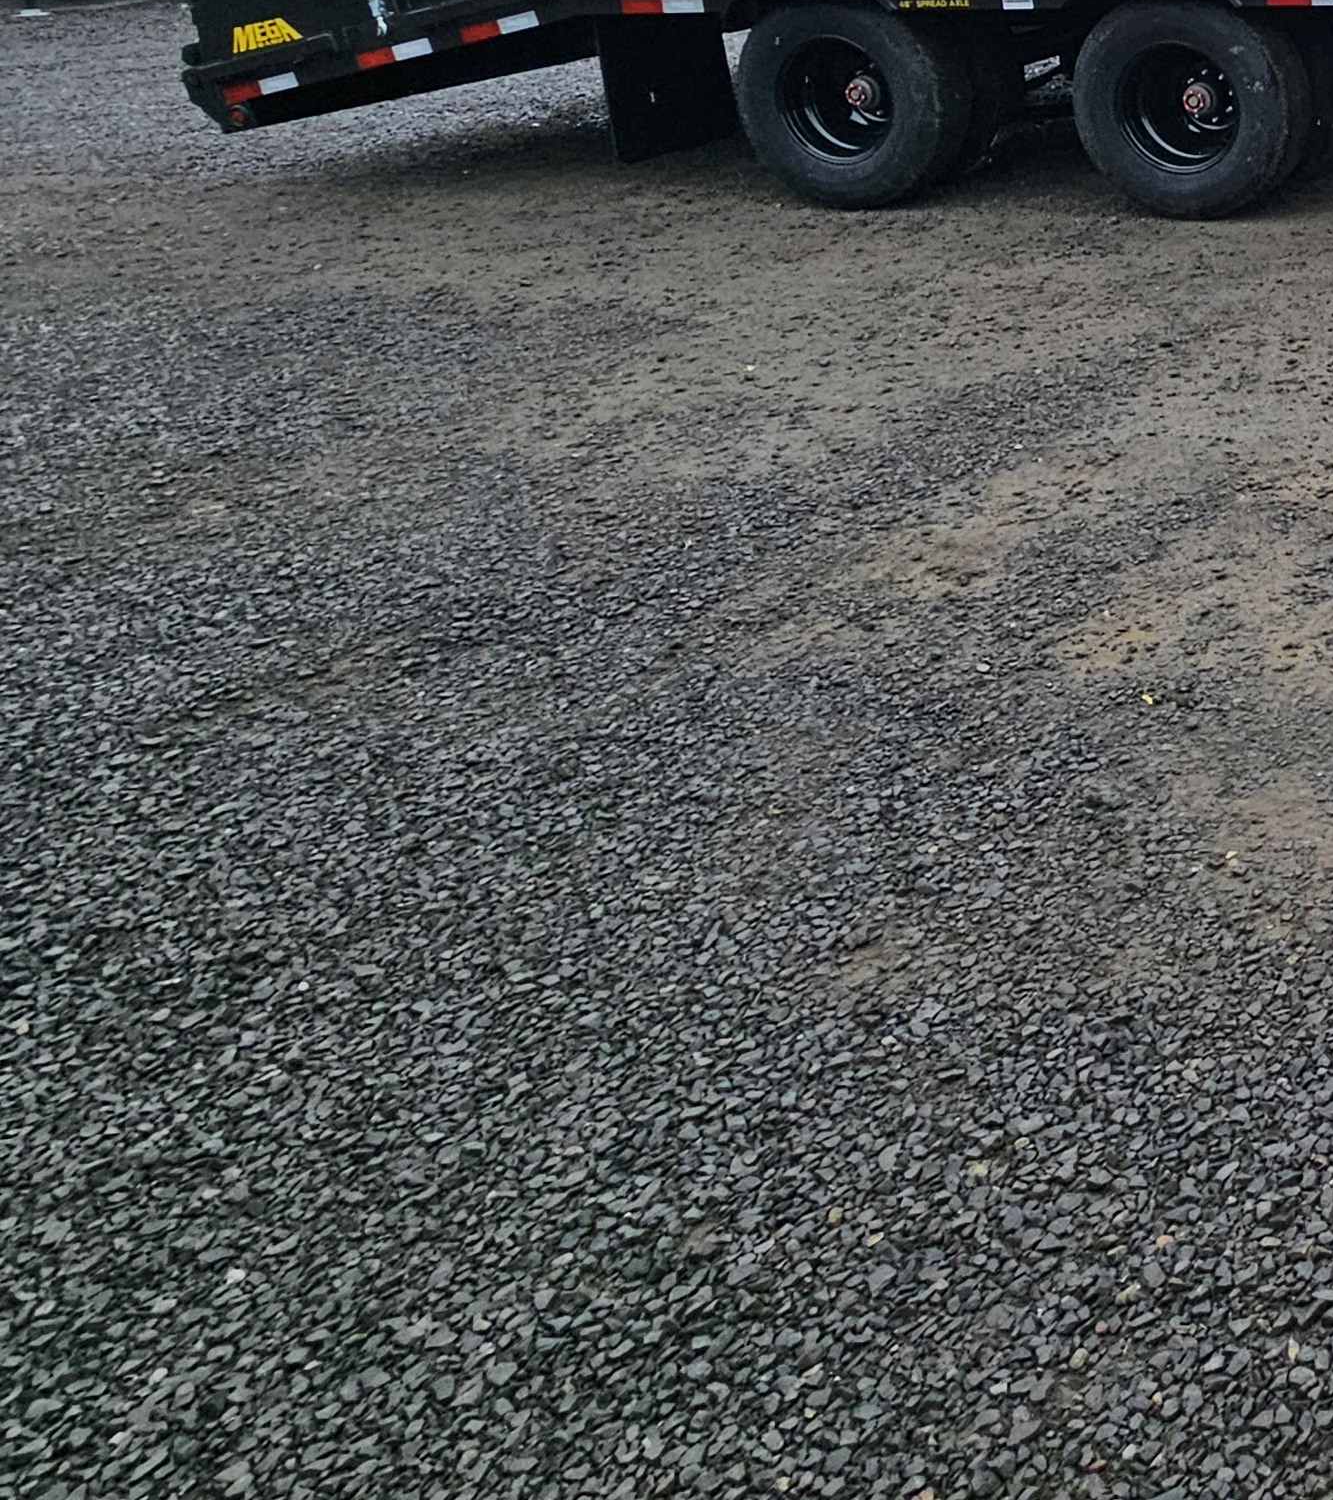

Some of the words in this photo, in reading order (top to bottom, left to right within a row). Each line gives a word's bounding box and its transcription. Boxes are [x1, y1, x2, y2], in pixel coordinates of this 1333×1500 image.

[916, 0, 947, 8] SPREAD
[949, 0, 970, 7] AXLE
[232, 17, 304, 54] MEGA
